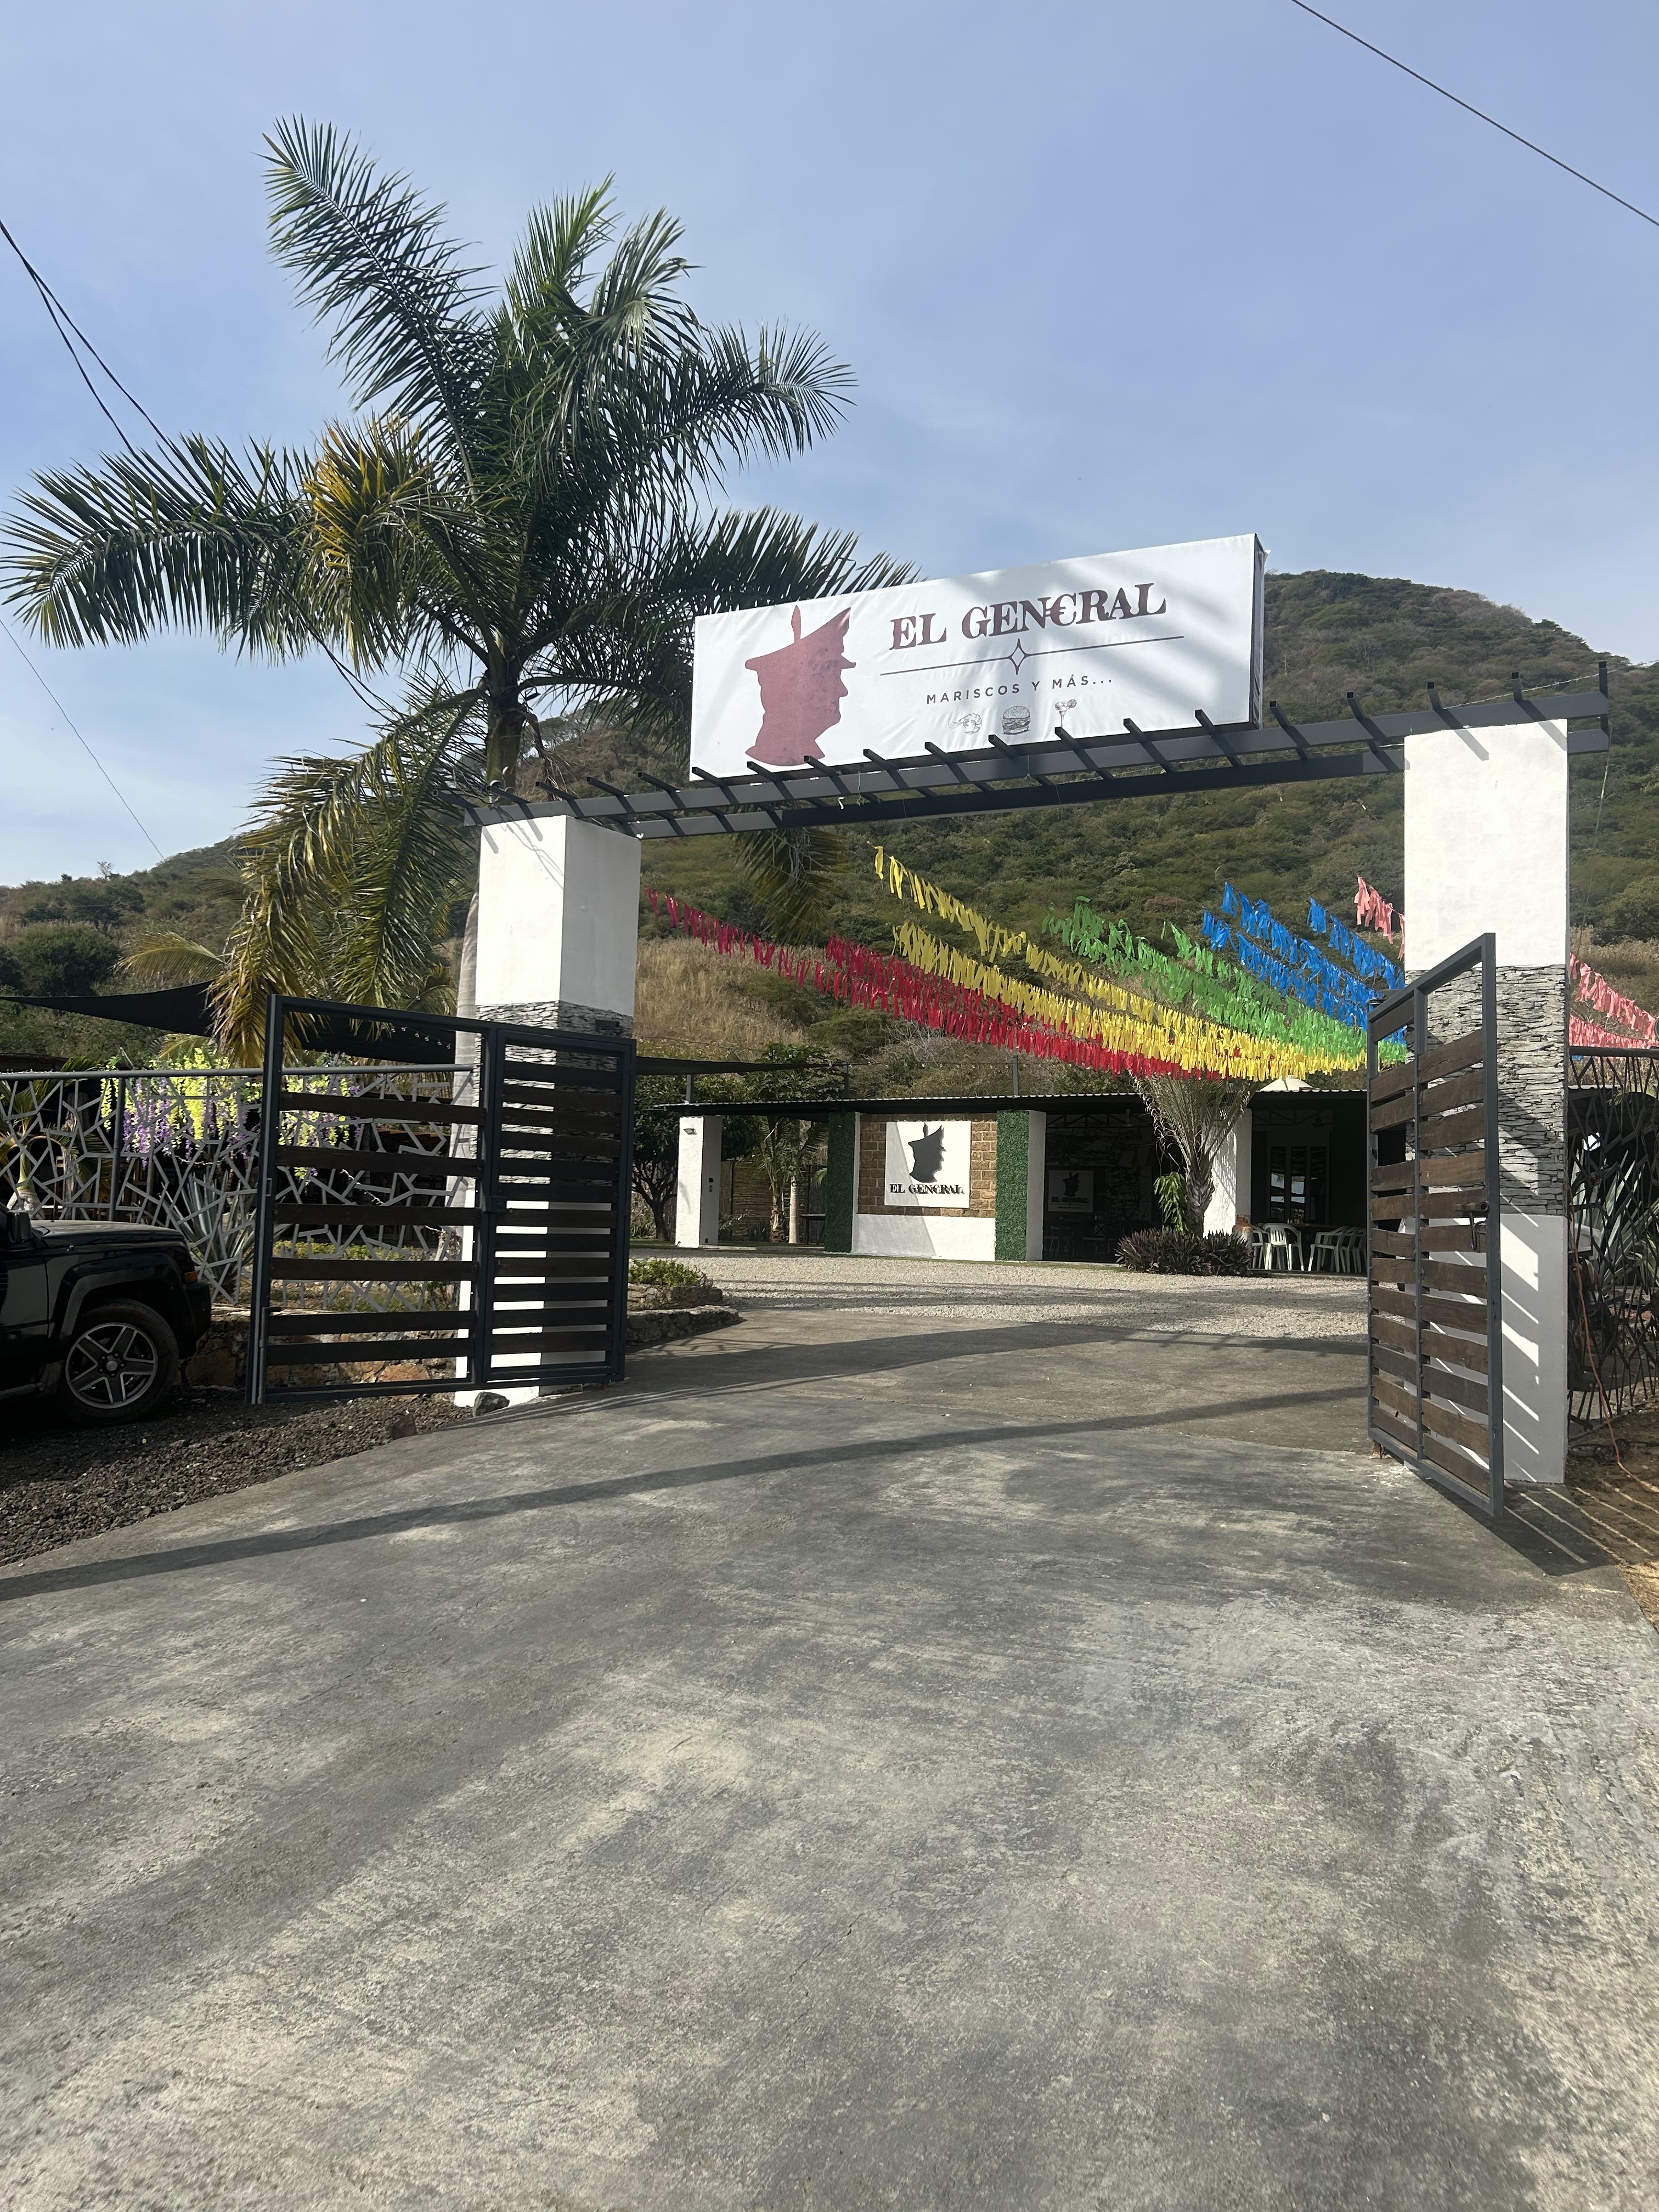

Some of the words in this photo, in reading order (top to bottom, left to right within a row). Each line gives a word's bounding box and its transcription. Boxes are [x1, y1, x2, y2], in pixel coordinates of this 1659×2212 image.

[889, 613, 947, 651] EL
[926, 684, 1020, 704] MARISCOS
[1031, 681, 1040, 691] Y
[1052, 674, 1112, 689] MÁS...
[889, 1184, 906, 1193] EL
